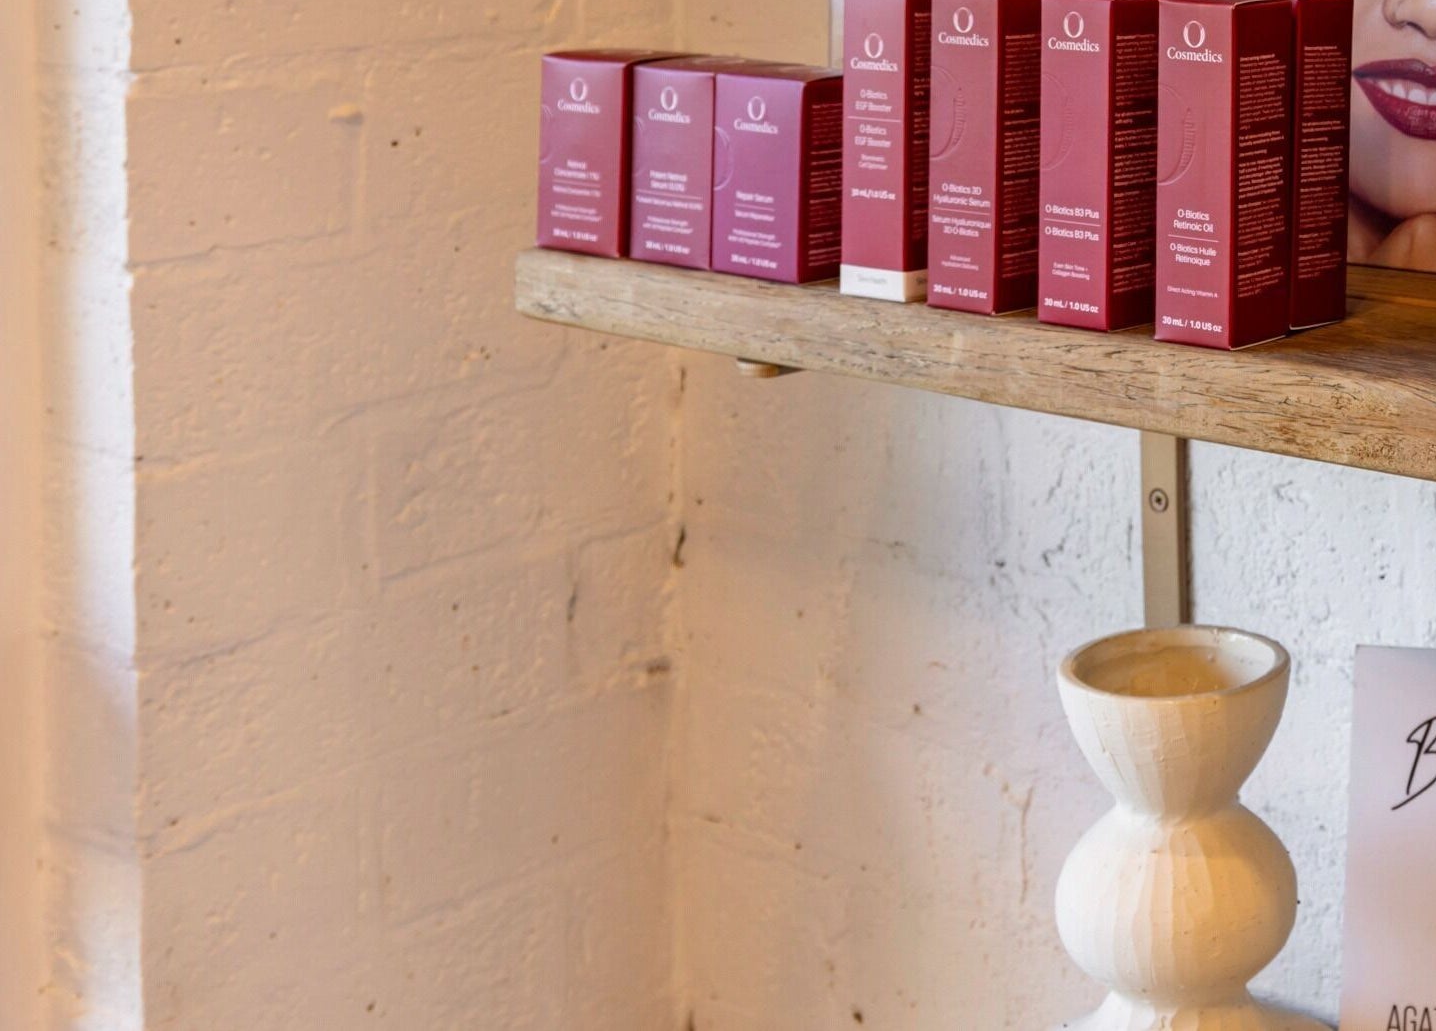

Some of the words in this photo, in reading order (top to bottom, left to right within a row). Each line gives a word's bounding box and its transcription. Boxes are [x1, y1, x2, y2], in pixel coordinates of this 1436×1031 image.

[938, 32, 989, 47] Cosmedics
[1048, 37, 1100, 52] Cosmedics
[1167, 47, 1223, 64] Cosmedics
[1203, 223, 1214, 233] Oil
